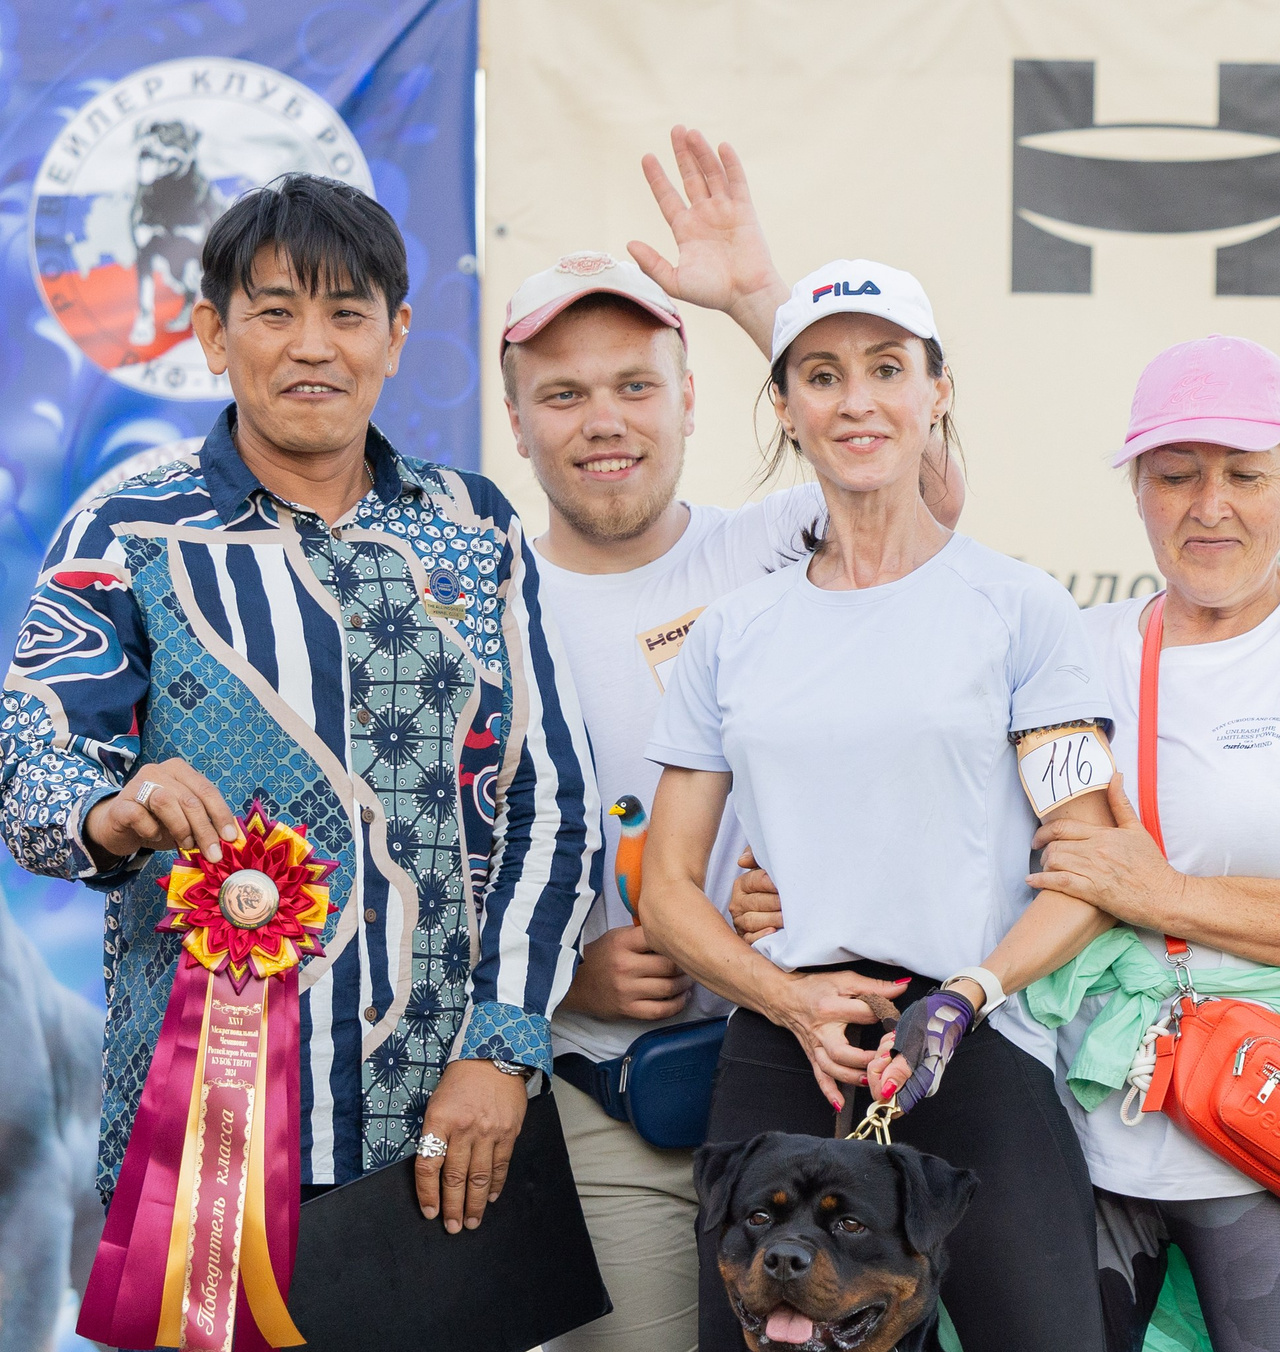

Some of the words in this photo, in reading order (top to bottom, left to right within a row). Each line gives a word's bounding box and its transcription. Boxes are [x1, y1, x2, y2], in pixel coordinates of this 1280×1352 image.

[191, 70, 304, 121] КЛУБ
[812, 280, 881, 303] FILA
[1212, 722, 1227, 733] STAY
[1227, 717, 1255, 726] CURIOUS
[1225, 726, 1260, 735] UNLEASH
[1256, 732, 1280, 740] POWER
[1223, 742, 1254, 750] curious
[1254, 740, 1273, 749] MIND
[1041, 735, 1093, 802] 116
[224, 1068, 237, 1077] 2024
[196, 1196, 226, 1336] Победитель
[216, 1107, 235, 1187] класса
